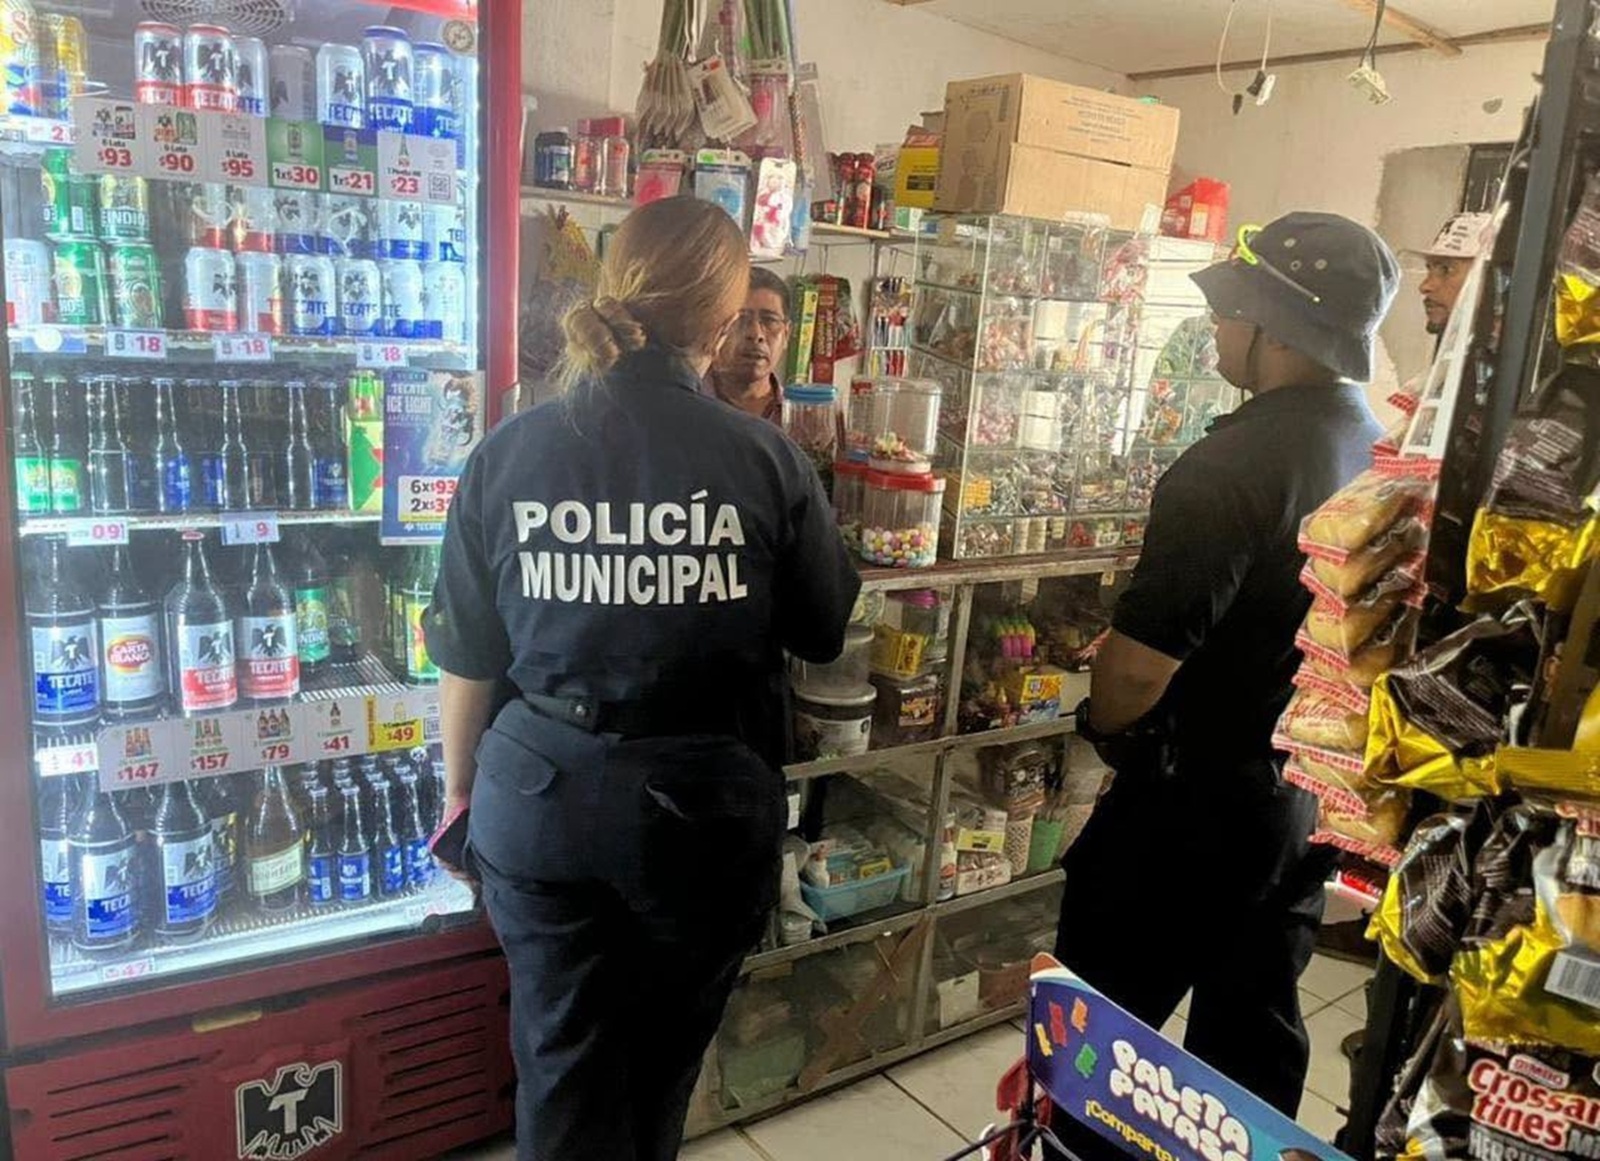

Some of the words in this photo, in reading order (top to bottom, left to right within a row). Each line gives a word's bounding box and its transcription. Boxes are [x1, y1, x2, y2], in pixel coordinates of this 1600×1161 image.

[98, 148, 133, 167] $93
[159, 153, 194, 172] $90
[222, 158, 255, 178] $95
[391, 177, 420, 194] $23
[513, 489, 746, 546] POLICÍA
[518, 551, 748, 605] MUNICIPAL
[1112, 1039, 1250, 1150] PALETA
[1473, 1095, 1565, 1147] tines
